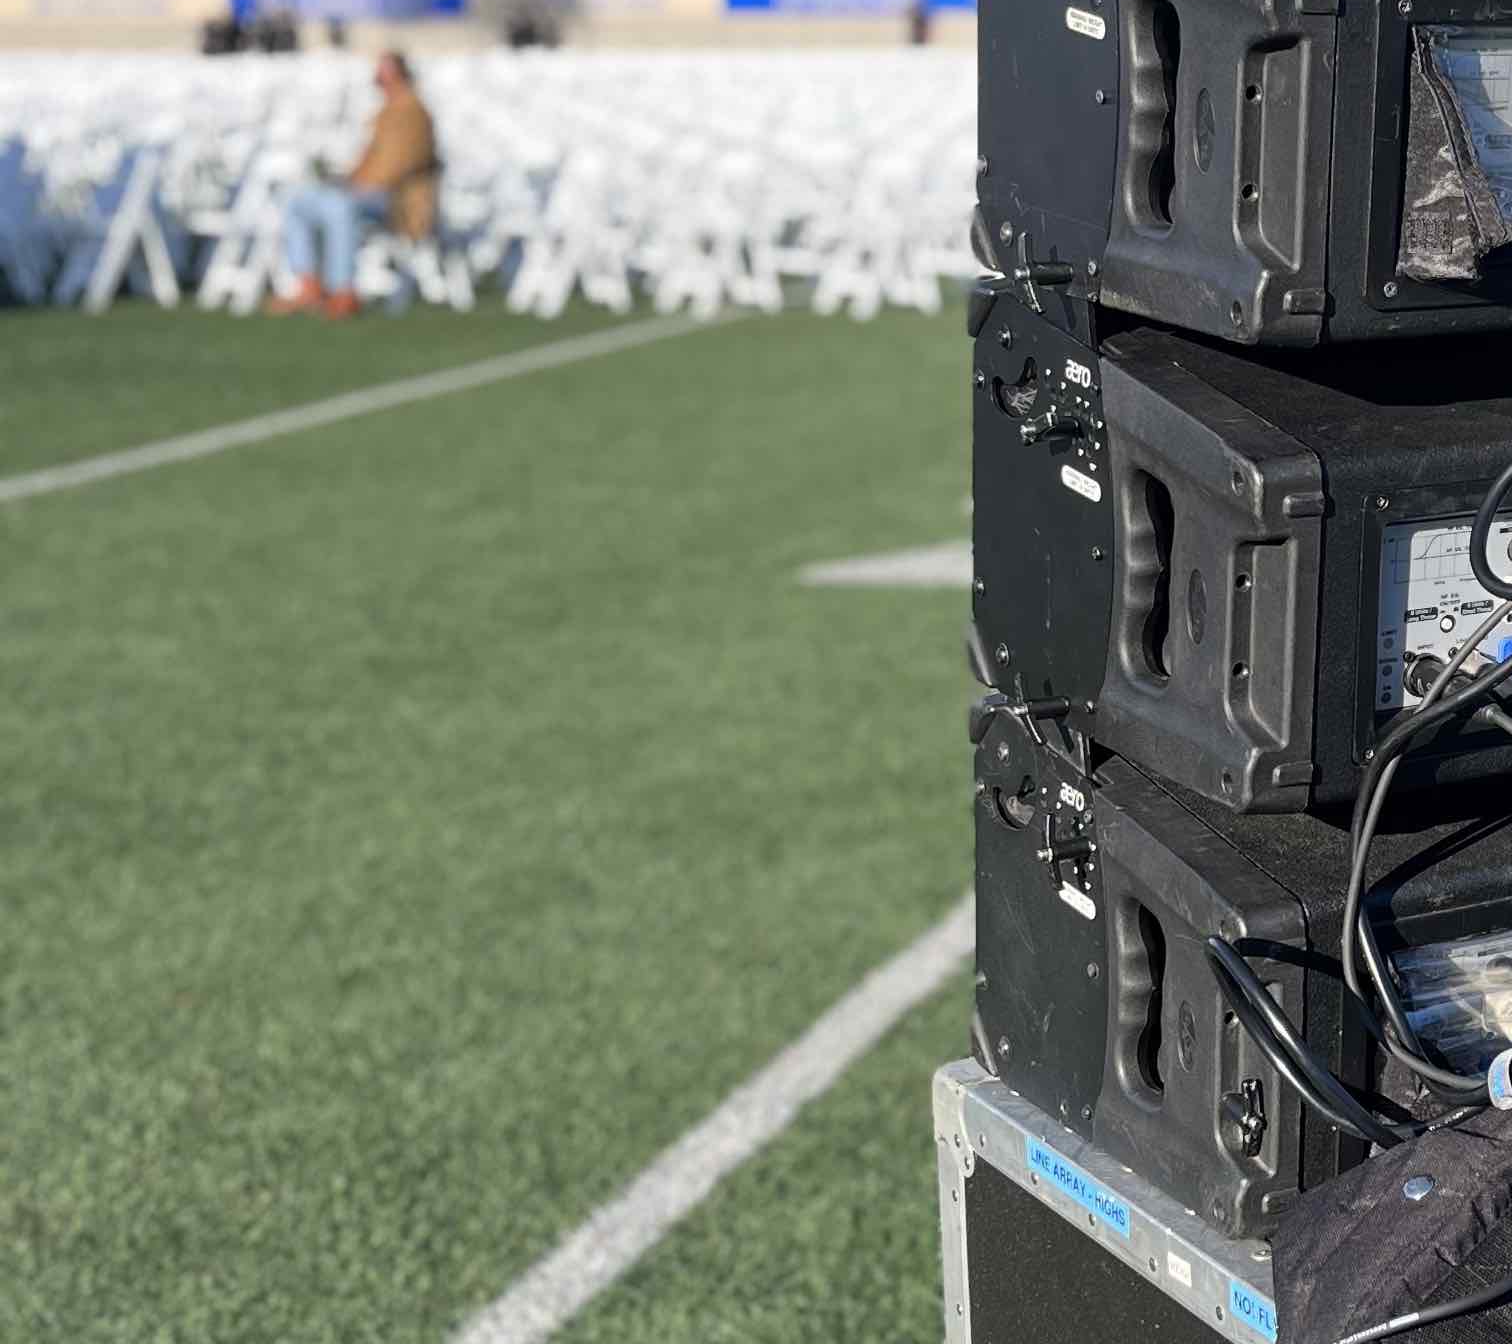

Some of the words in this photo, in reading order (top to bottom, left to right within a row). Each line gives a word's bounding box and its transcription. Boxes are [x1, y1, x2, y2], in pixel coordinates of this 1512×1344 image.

[1031, 1147, 1050, 1172] LINE
[1053, 1164, 1086, 1197] ARRAY
[1095, 1193, 1126, 1227] HIGHS
[1259, 1308, 1277, 1331] FL
